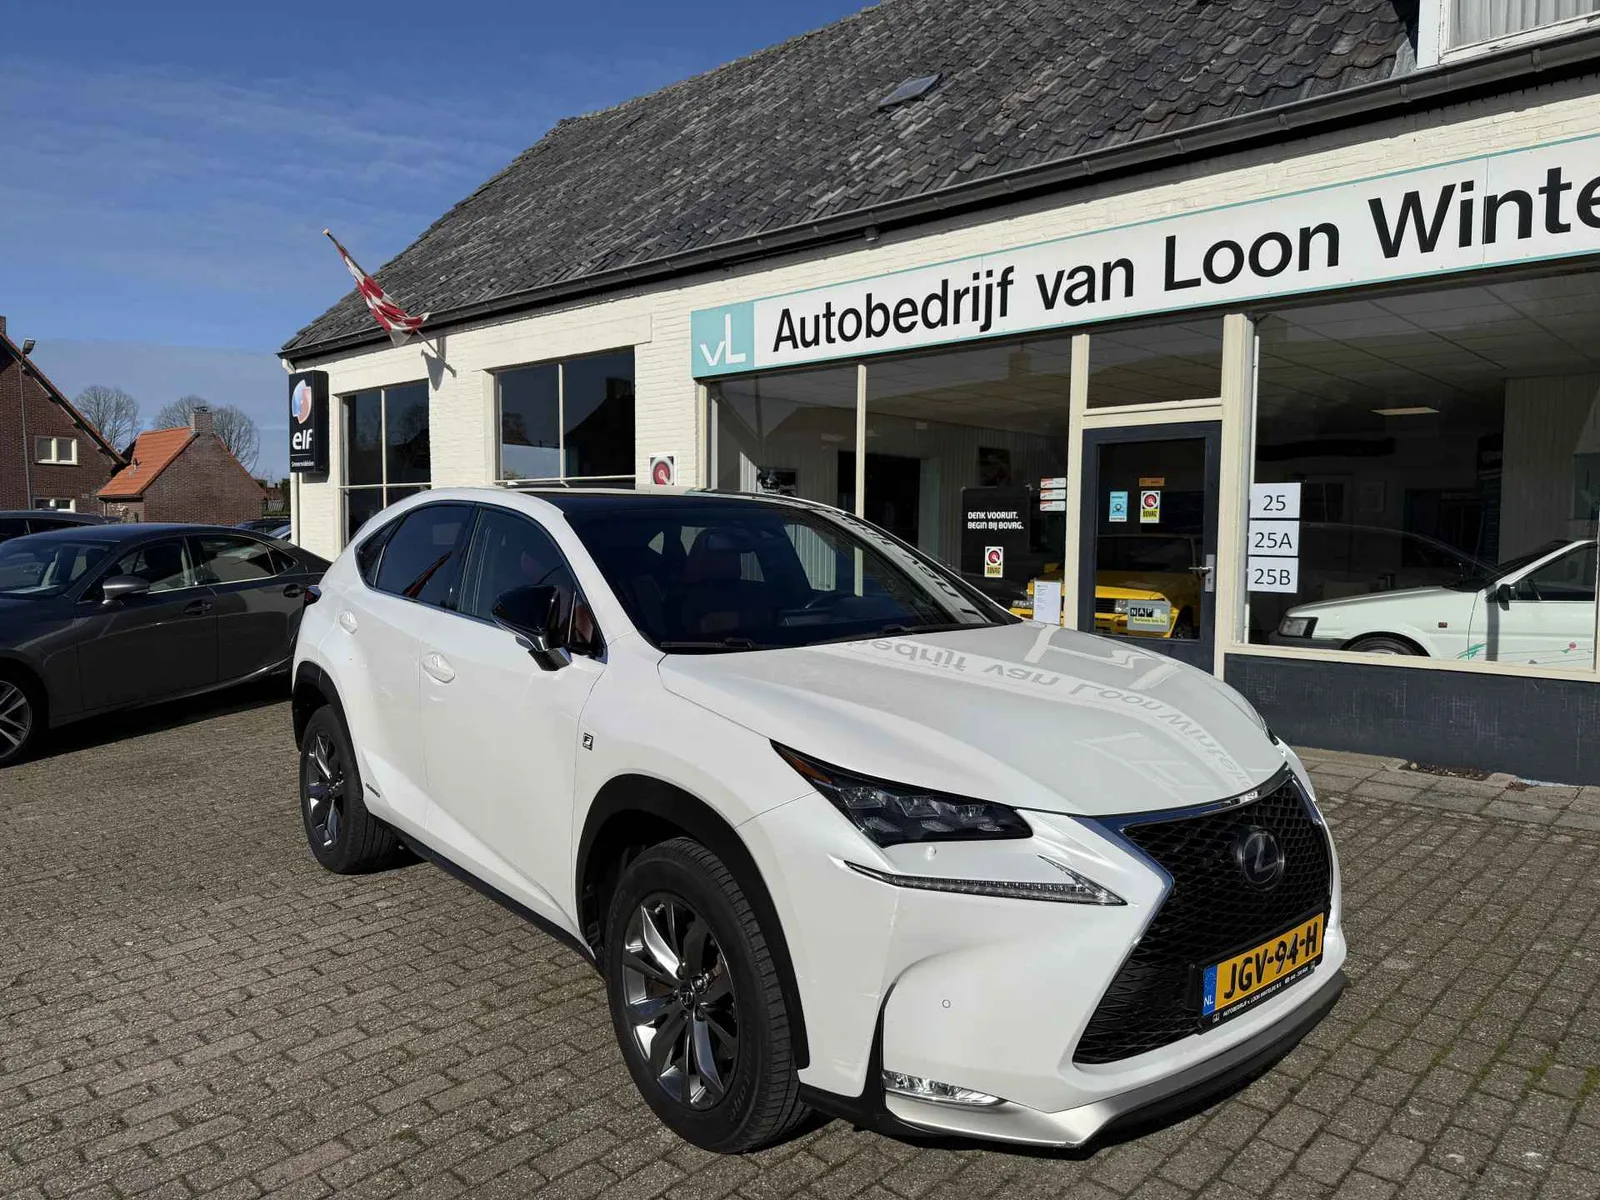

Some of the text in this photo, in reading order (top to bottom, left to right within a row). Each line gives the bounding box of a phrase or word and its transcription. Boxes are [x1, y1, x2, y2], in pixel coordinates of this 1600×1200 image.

[773, 265, 1014, 352] Autobedrijf
[1036, 257, 1135, 310] van
[1164, 221, 1341, 292] Loon
[292, 429, 313, 450] elf
[1263, 494, 1286, 511] 25
[967, 511, 1019, 520] DENK VOORUIT.
[967, 521, 987, 530] BEGIN
[998, 521, 1024, 530] BOVAG.
[1254, 531, 1293, 549] 25A
[1254, 568, 1291, 586] 25B
[1203, 995, 1214, 1007] NL
[1223, 921, 1318, 1000] JGV-94-H
